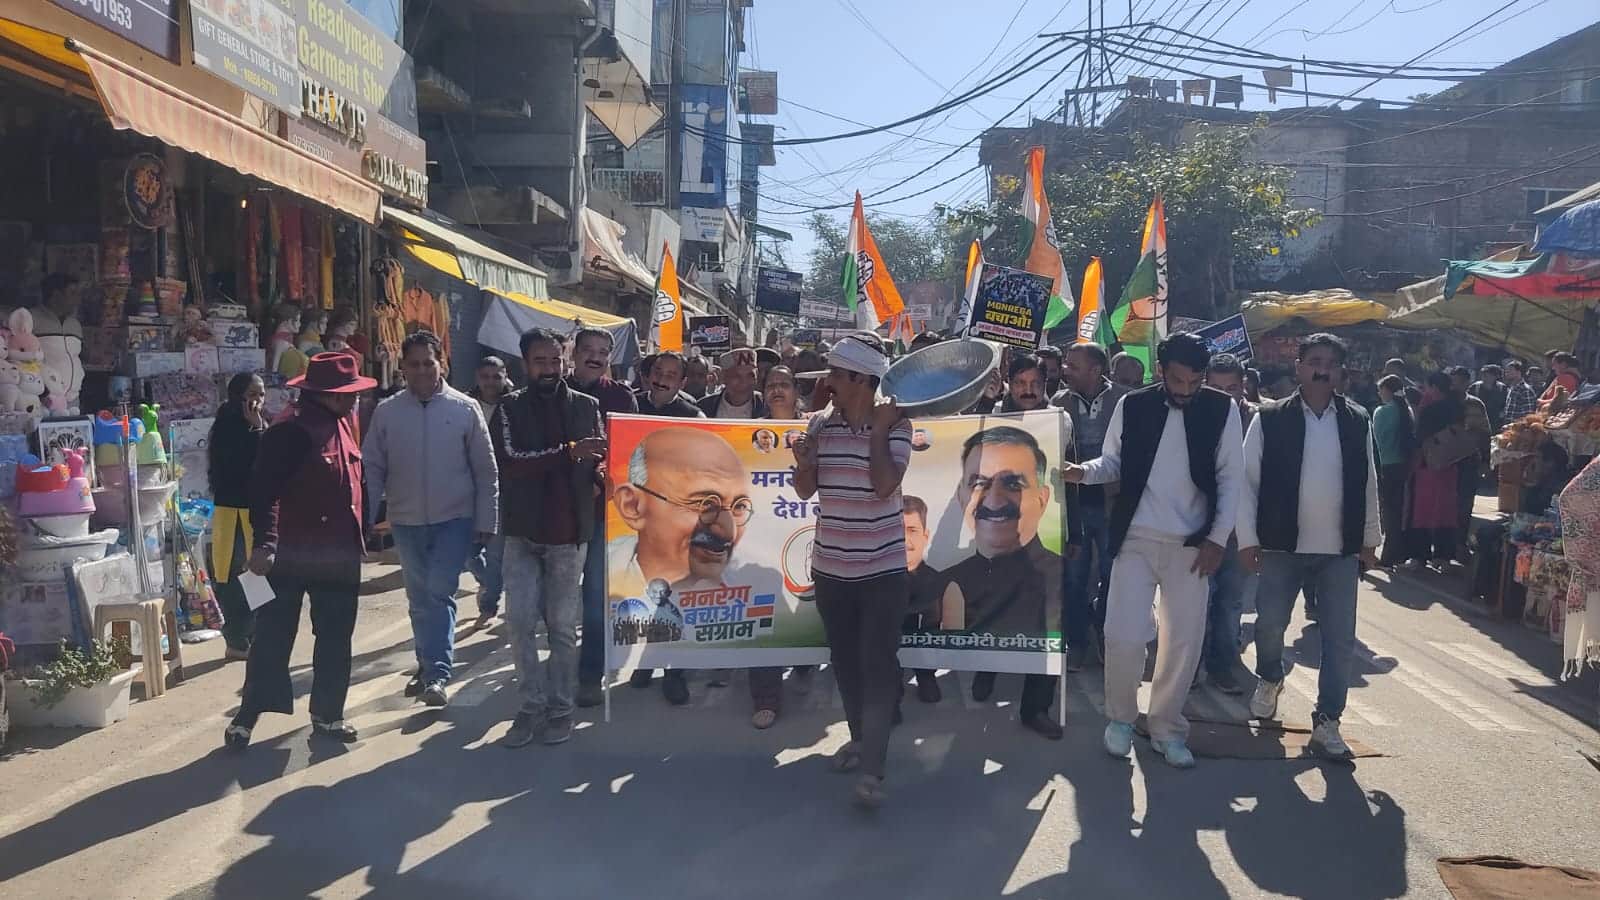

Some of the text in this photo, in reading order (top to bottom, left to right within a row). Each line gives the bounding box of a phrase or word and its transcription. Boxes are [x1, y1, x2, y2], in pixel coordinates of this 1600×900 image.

[73, 0, 132, 29] -01953
[198, 17, 215, 40] GIFT
[217, 28, 250, 60] GENERAL
[250, 48, 271, 73] STORE
[308, 0, 384, 71] Readymade
[298, 25, 359, 95] Garment
[984, 310, 1033, 329] बचाओ!
[986, 300, 1033, 316] MONREGA
[772, 496, 808, 519] देश
[679, 583, 752, 608] मनरेगा
[683, 599, 745, 625] बचाओ
[950, 632, 996, 648] कमेटी
[998, 633, 1062, 651] हमीरपुर
